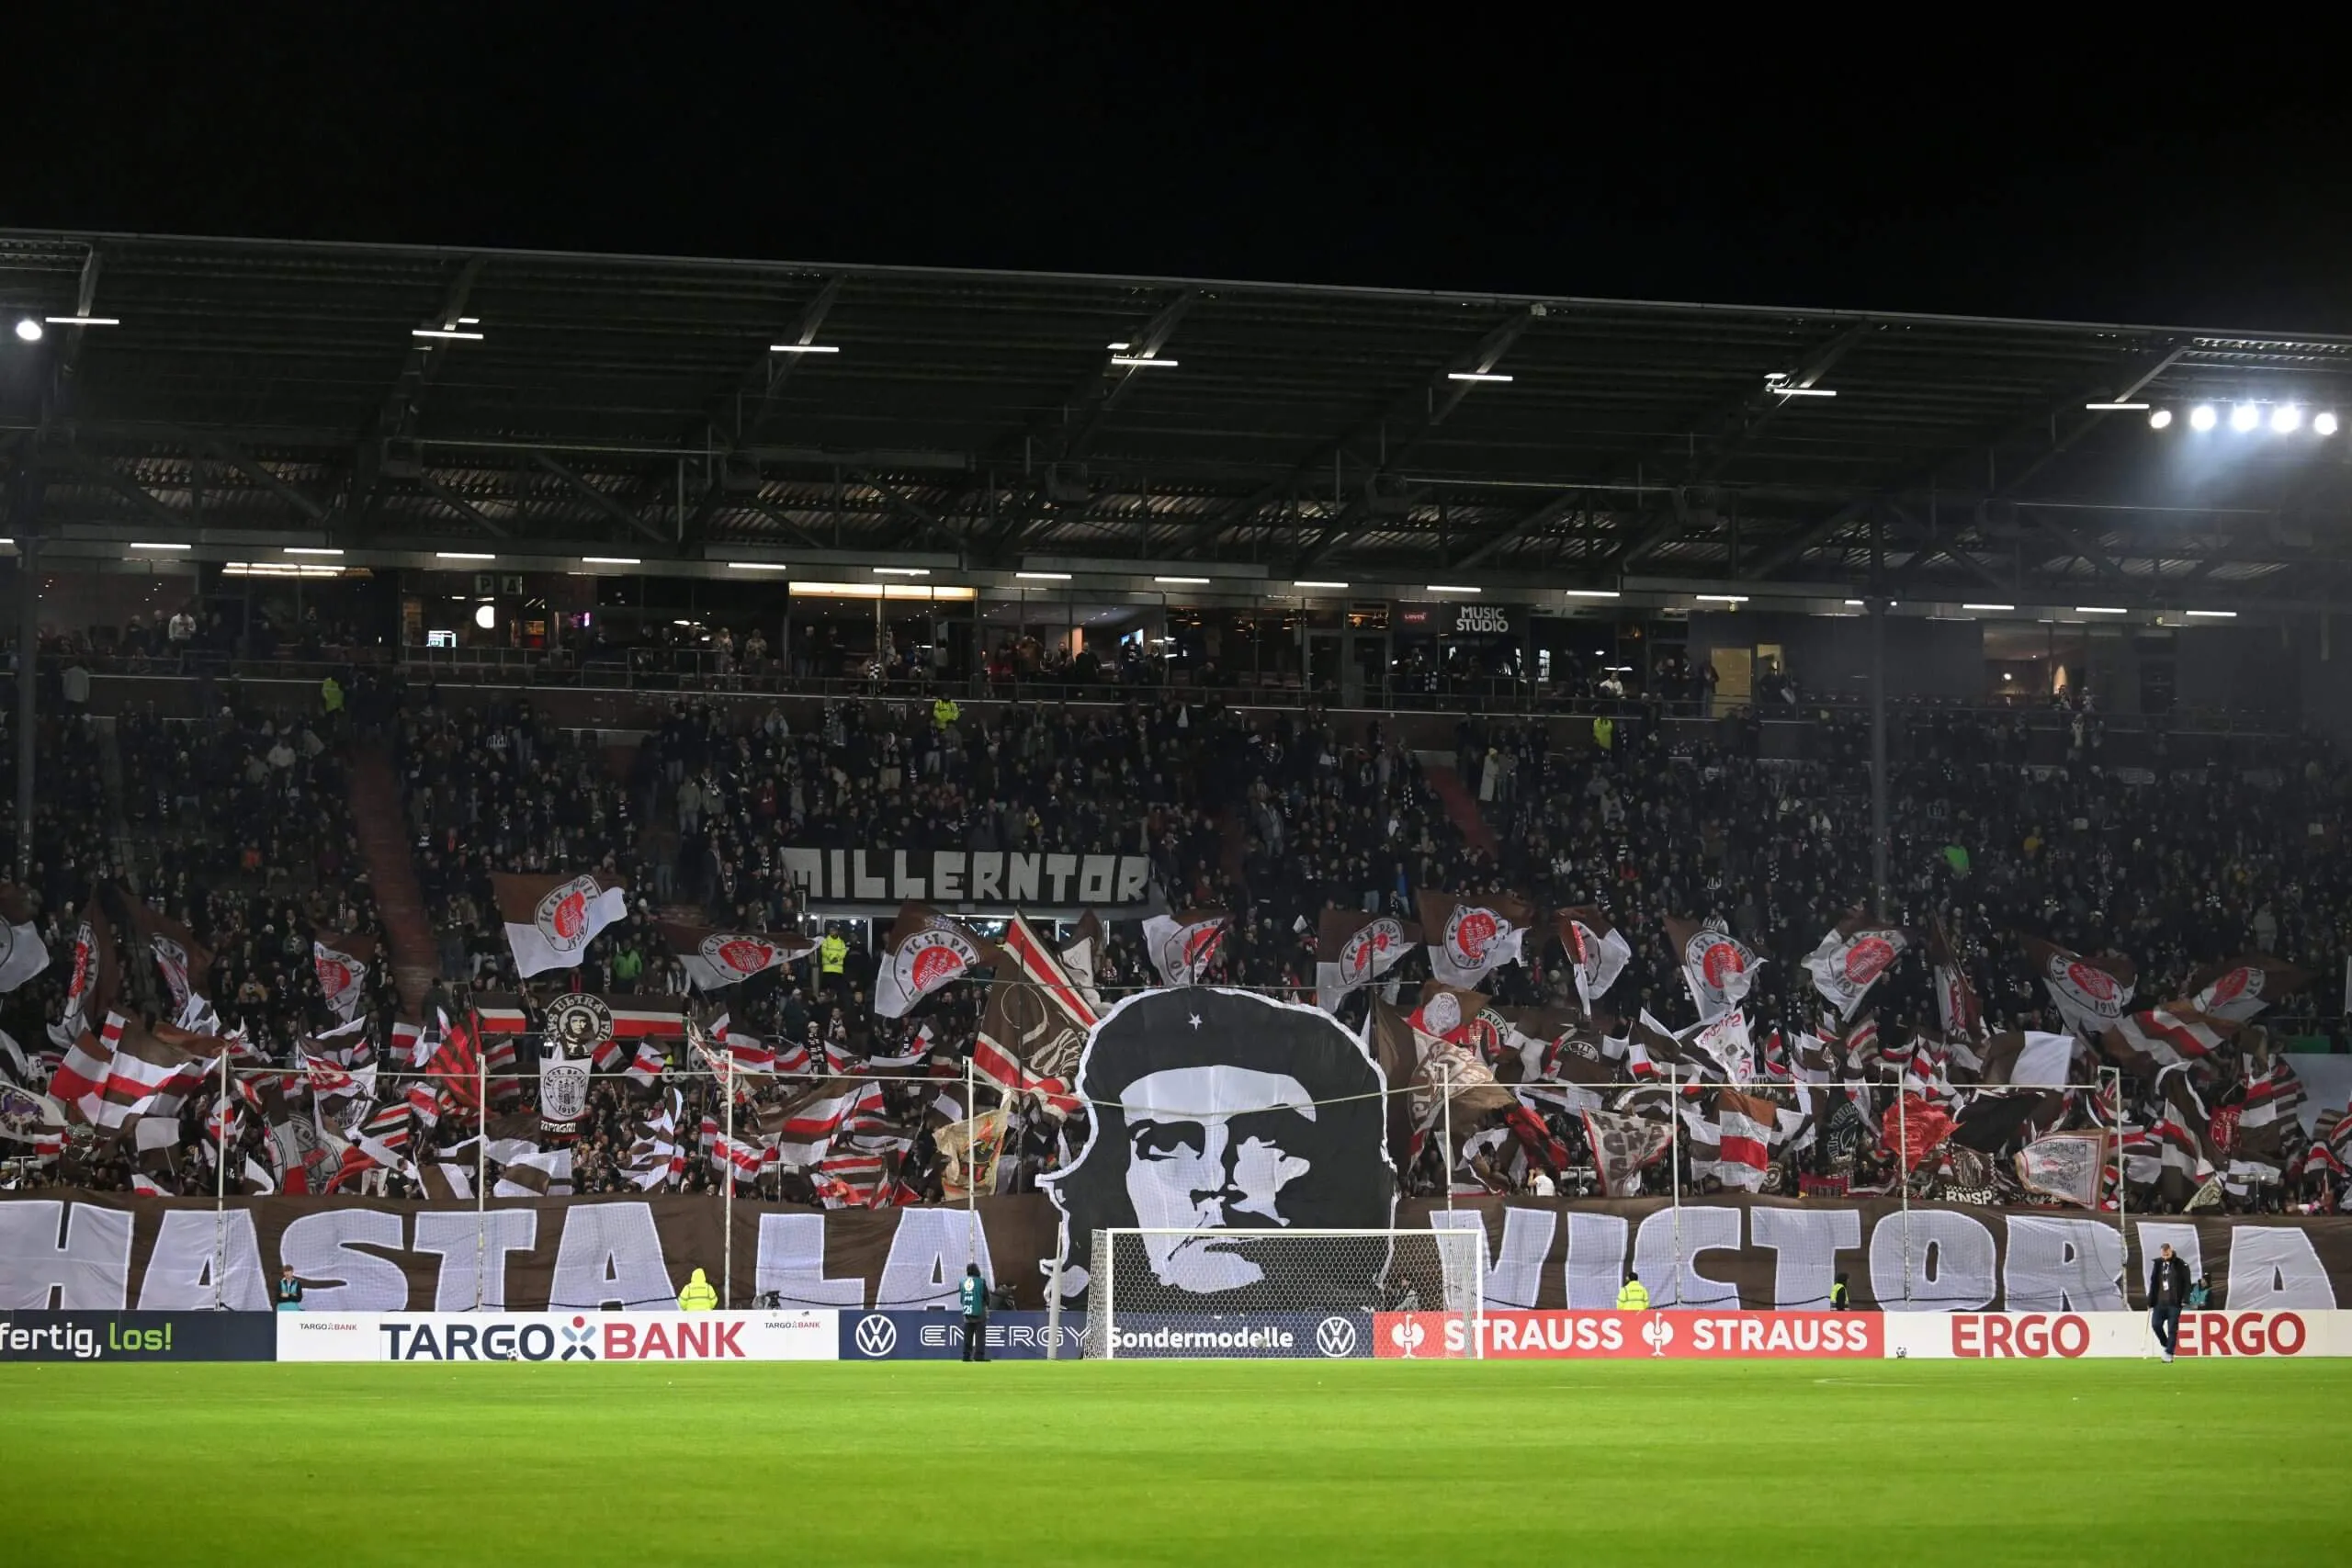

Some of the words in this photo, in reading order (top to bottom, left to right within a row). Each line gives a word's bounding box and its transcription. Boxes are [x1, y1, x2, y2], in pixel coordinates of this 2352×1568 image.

[1456, 618, 1510, 633] STUDIO
[1461, 605, 1505, 619] MUSIC
[780, 846, 1150, 903] MILLERNTOR
[905, 939, 921, 955] FC
[925, 933, 944, 945] ST.
[558, 1105, 576, 1114] 1910
[0, 1200, 679, 1312] HASTA
[756, 1207, 996, 1311] LA
[1430, 1206, 2337, 1312] VICTORIA
[0, 1322, 103, 1359] fertig,
[108, 1323, 172, 1351] los!
[1111, 1325, 1294, 1349] Sondermodelle
[1443, 1318, 1623, 1352] STRAUSS
[1692, 1318, 1869, 1352] STRAUSS
[1952, 1314, 2090, 1359] ERGO
[2174, 1313, 2307, 1358] ERGO
